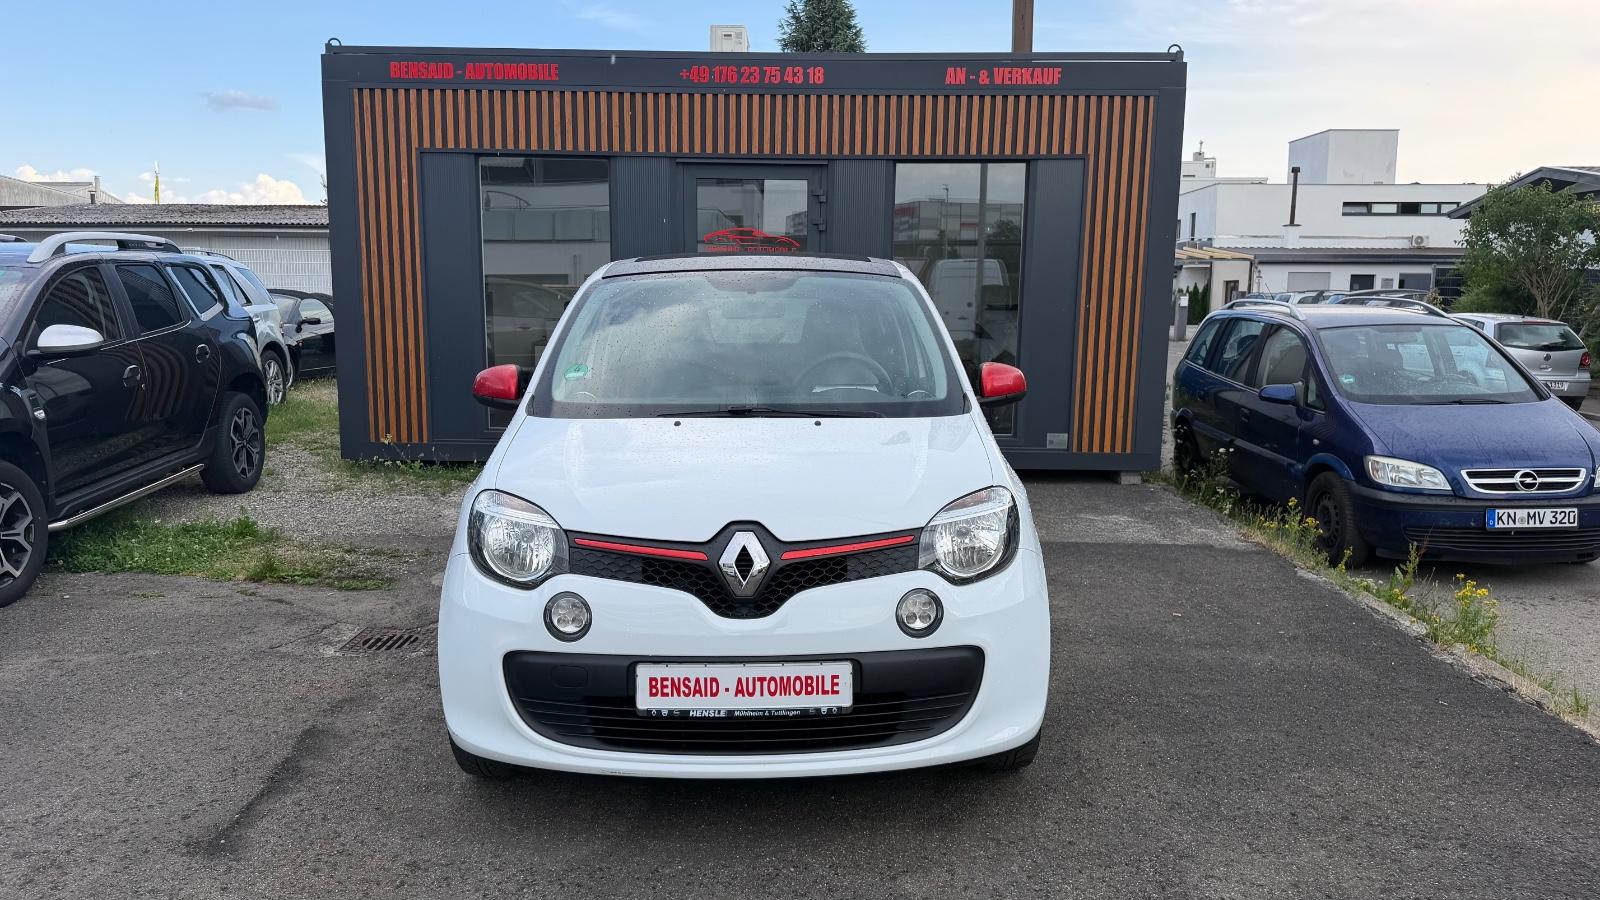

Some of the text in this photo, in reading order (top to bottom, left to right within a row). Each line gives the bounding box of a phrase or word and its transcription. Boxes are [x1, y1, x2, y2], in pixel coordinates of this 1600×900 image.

[390, 62, 454, 80] BENSAID
[465, 63, 559, 81] AUTOMOBILE
[680, 65, 825, 84] +49 176 23 75 43 18
[945, 67, 967, 85] AN
[979, 69, 990, 85] &
[993, 67, 1062, 85] VERKAUF
[1496, 510, 1577, 526] KN MV 320
[648, 676, 720, 698] BENSAID
[734, 674, 840, 698] AUTOMOBILE
[689, 709, 727, 717] HENSLE
[771, 709, 801, 717] Tuttlingen
